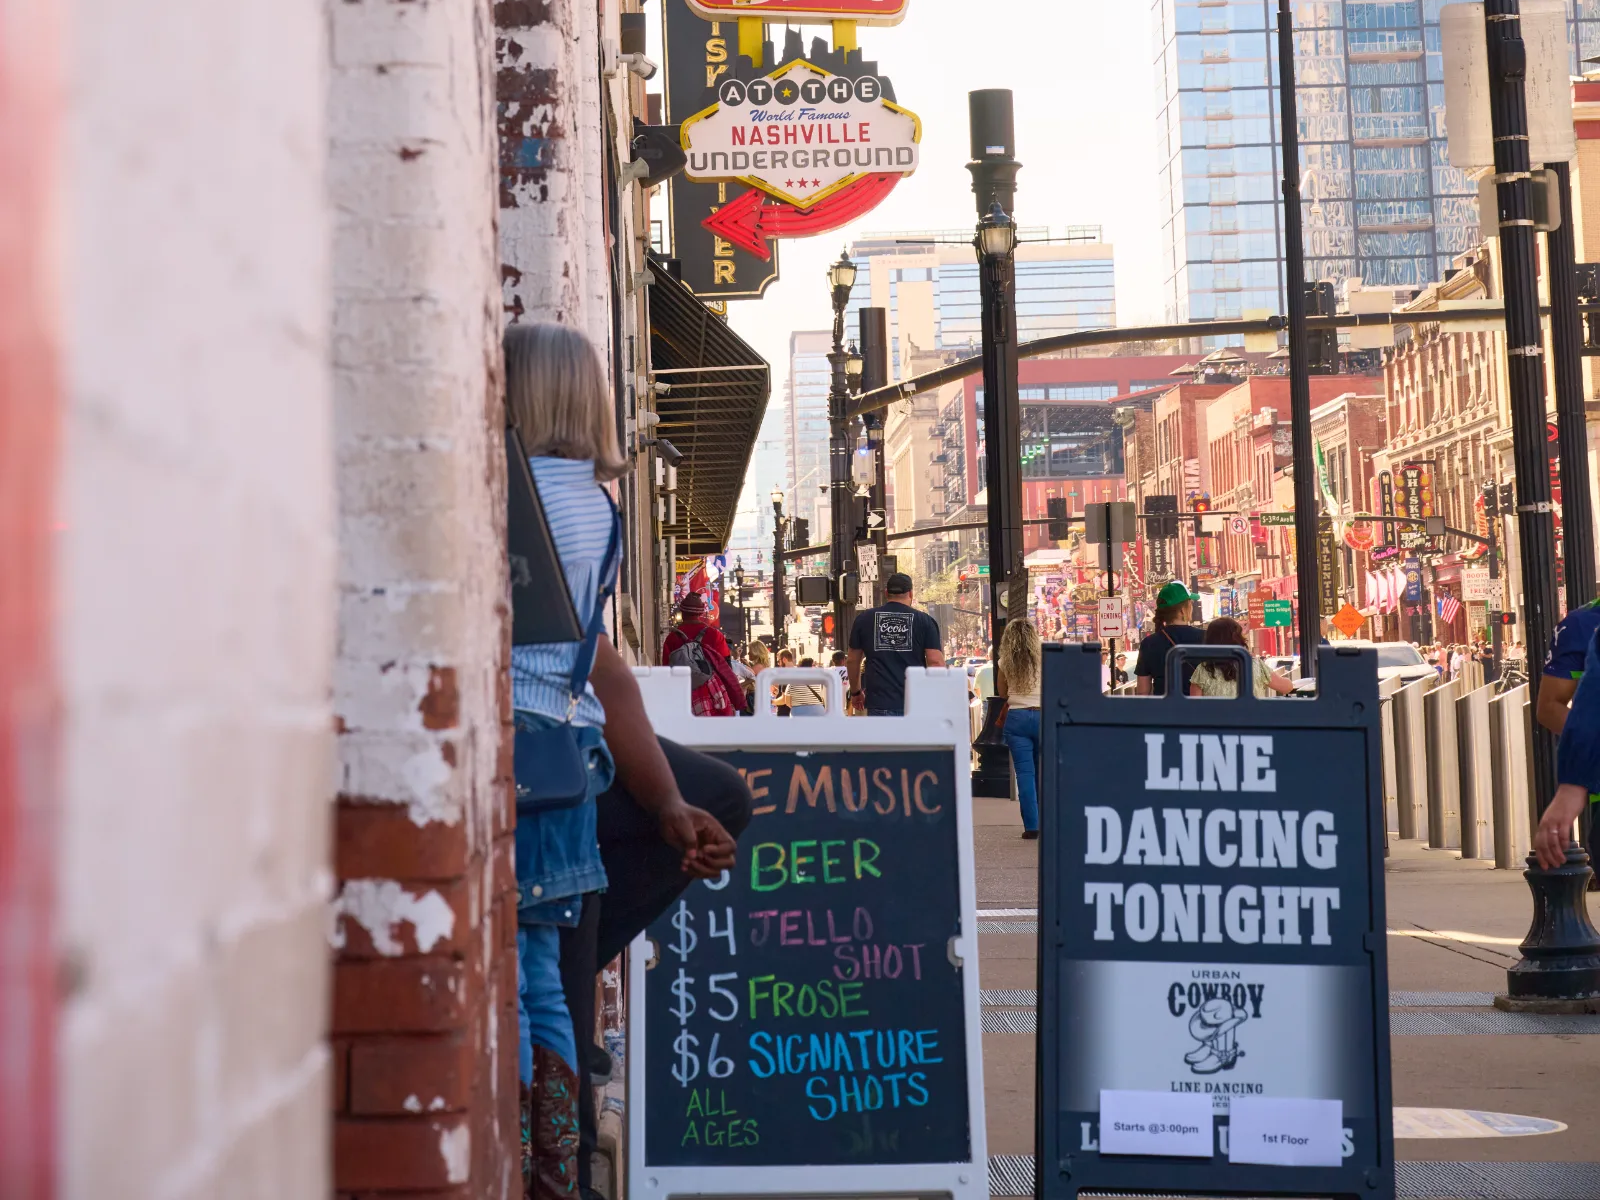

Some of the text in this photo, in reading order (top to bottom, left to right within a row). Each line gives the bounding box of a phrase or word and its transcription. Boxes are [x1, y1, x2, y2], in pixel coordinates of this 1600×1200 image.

[725, 81, 875, 102] AT THE
[750, 107, 852, 123] World Famous
[731, 121, 871, 146] NASHVILLE
[690, 145, 914, 172] UNDERGROUND
[1320, 538, 1334, 615] VALENTINE
[1100, 612, 1121, 620] VENDING
[1106, 603, 1115, 611] NO
[879, 622, 909, 633] Coors
[1143, 733, 1277, 793] LINE
[785, 763, 943, 818] MUSIC
[1084, 805, 1338, 870] DANCING
[750, 838, 882, 892] BEER
[748, 907, 874, 947] JELLO
[1084, 882, 1341, 946] TONIGHT
[832, 943, 926, 981] SHOT
[1191, 969, 1241, 980] URBAN
[749, 974, 870, 1020] FROSE
[1167, 981, 1265, 1019] COWBOY
[748, 1029, 944, 1079] SIGNATURE
[686, 1087, 738, 1118] ALL
[805, 1071, 930, 1122] SHOTS
[1170, 1080, 1264, 1095] LINE DANCING
[681, 1118, 760, 1148] AGES
[1113, 1121, 1200, 1136] Starts @3:00pm
[1262, 1133, 1310, 1146] 1st Floor
